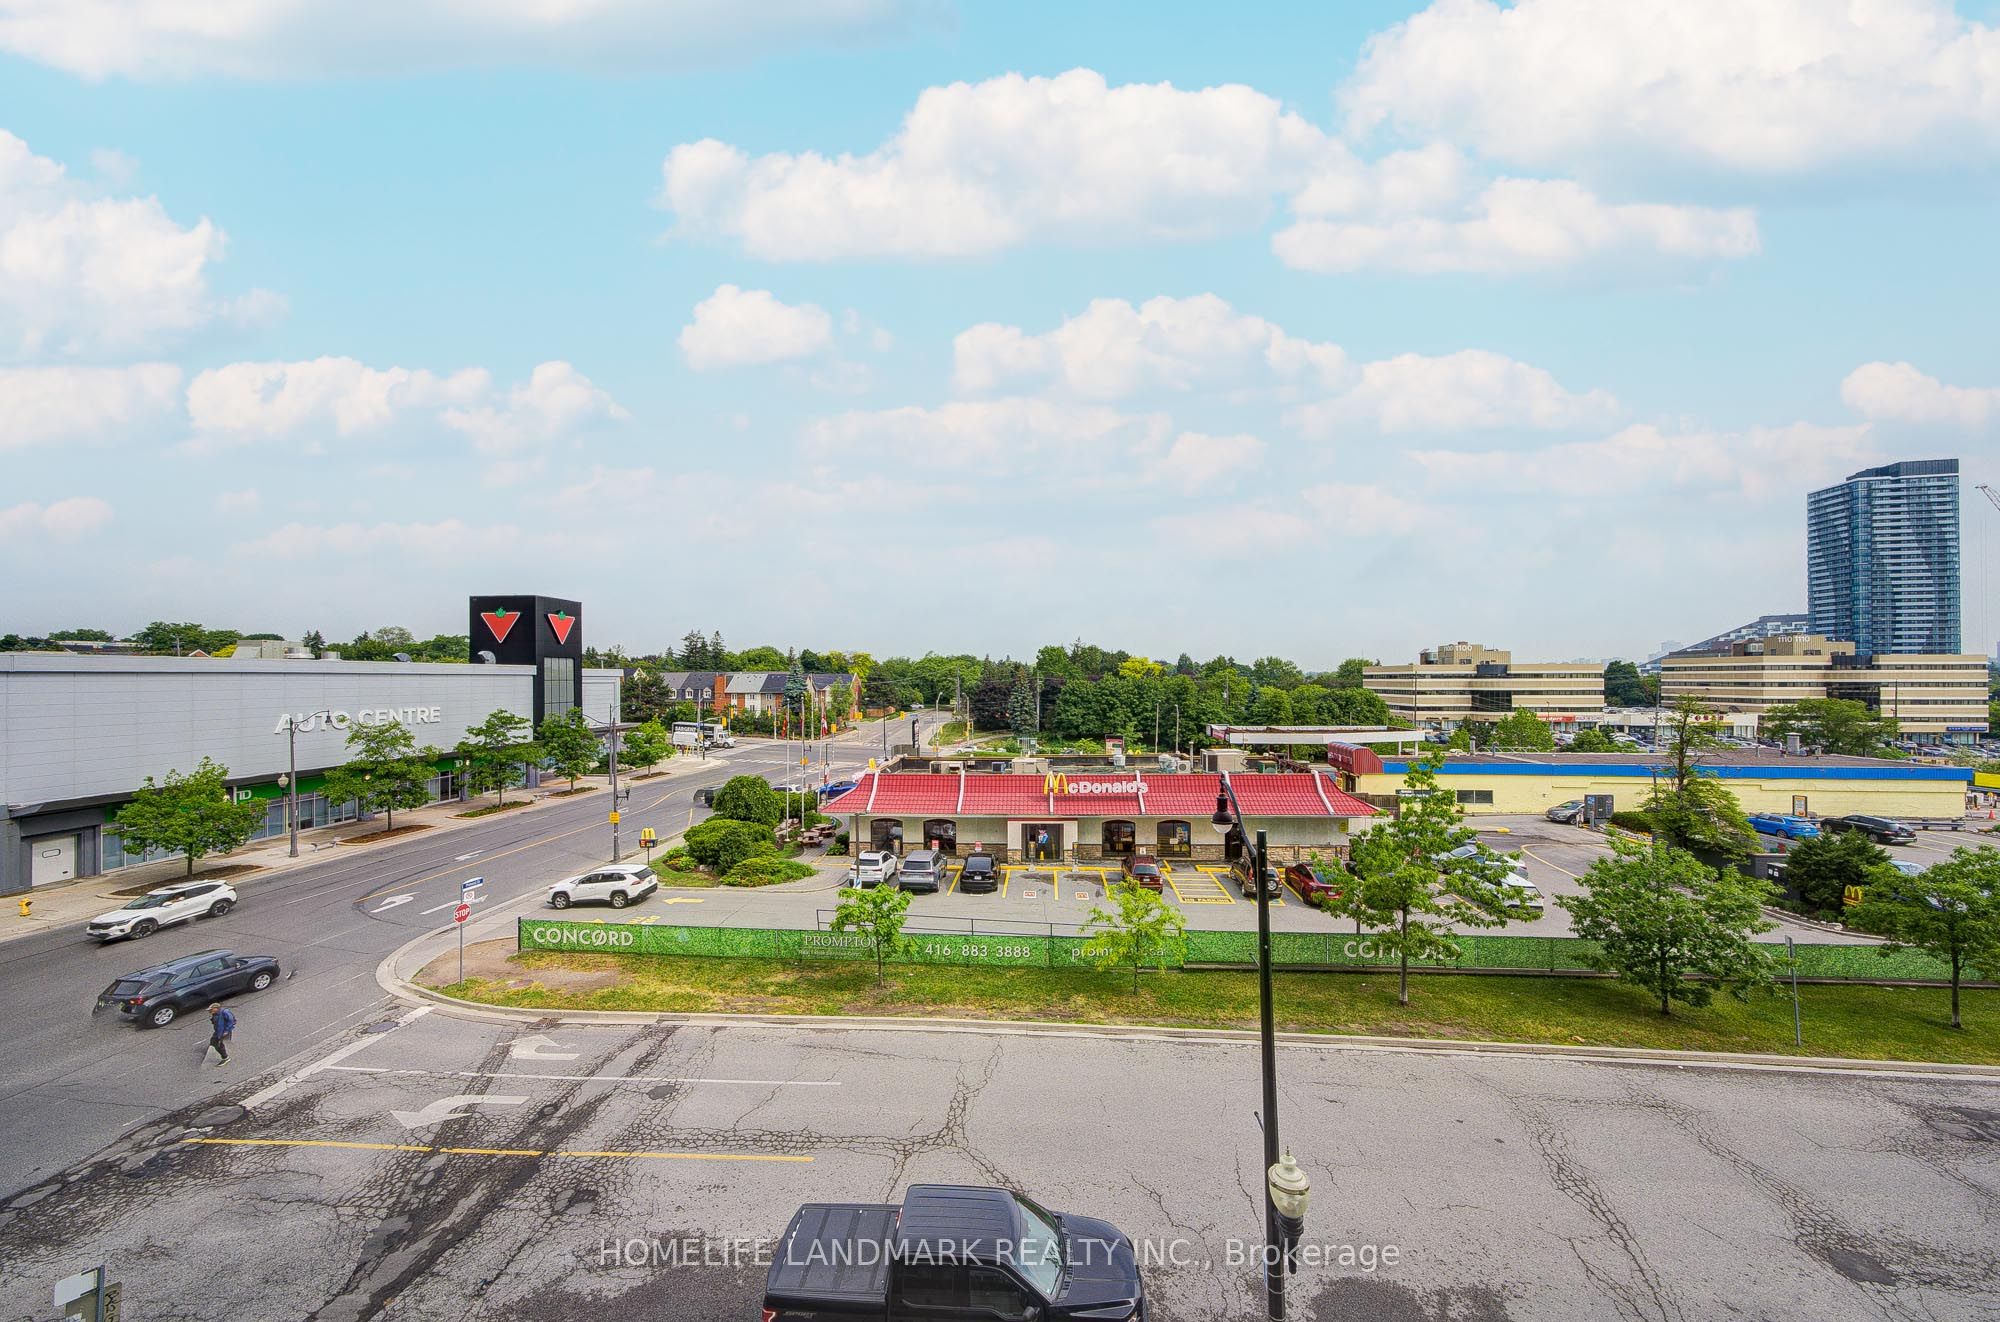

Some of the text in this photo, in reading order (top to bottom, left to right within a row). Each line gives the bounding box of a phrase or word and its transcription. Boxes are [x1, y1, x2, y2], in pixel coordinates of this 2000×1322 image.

[274, 706, 441, 735] AUTO CENTRE
[455, 907, 470, 919] STOP
[925, 943, 1031, 958] 416 883 3888
